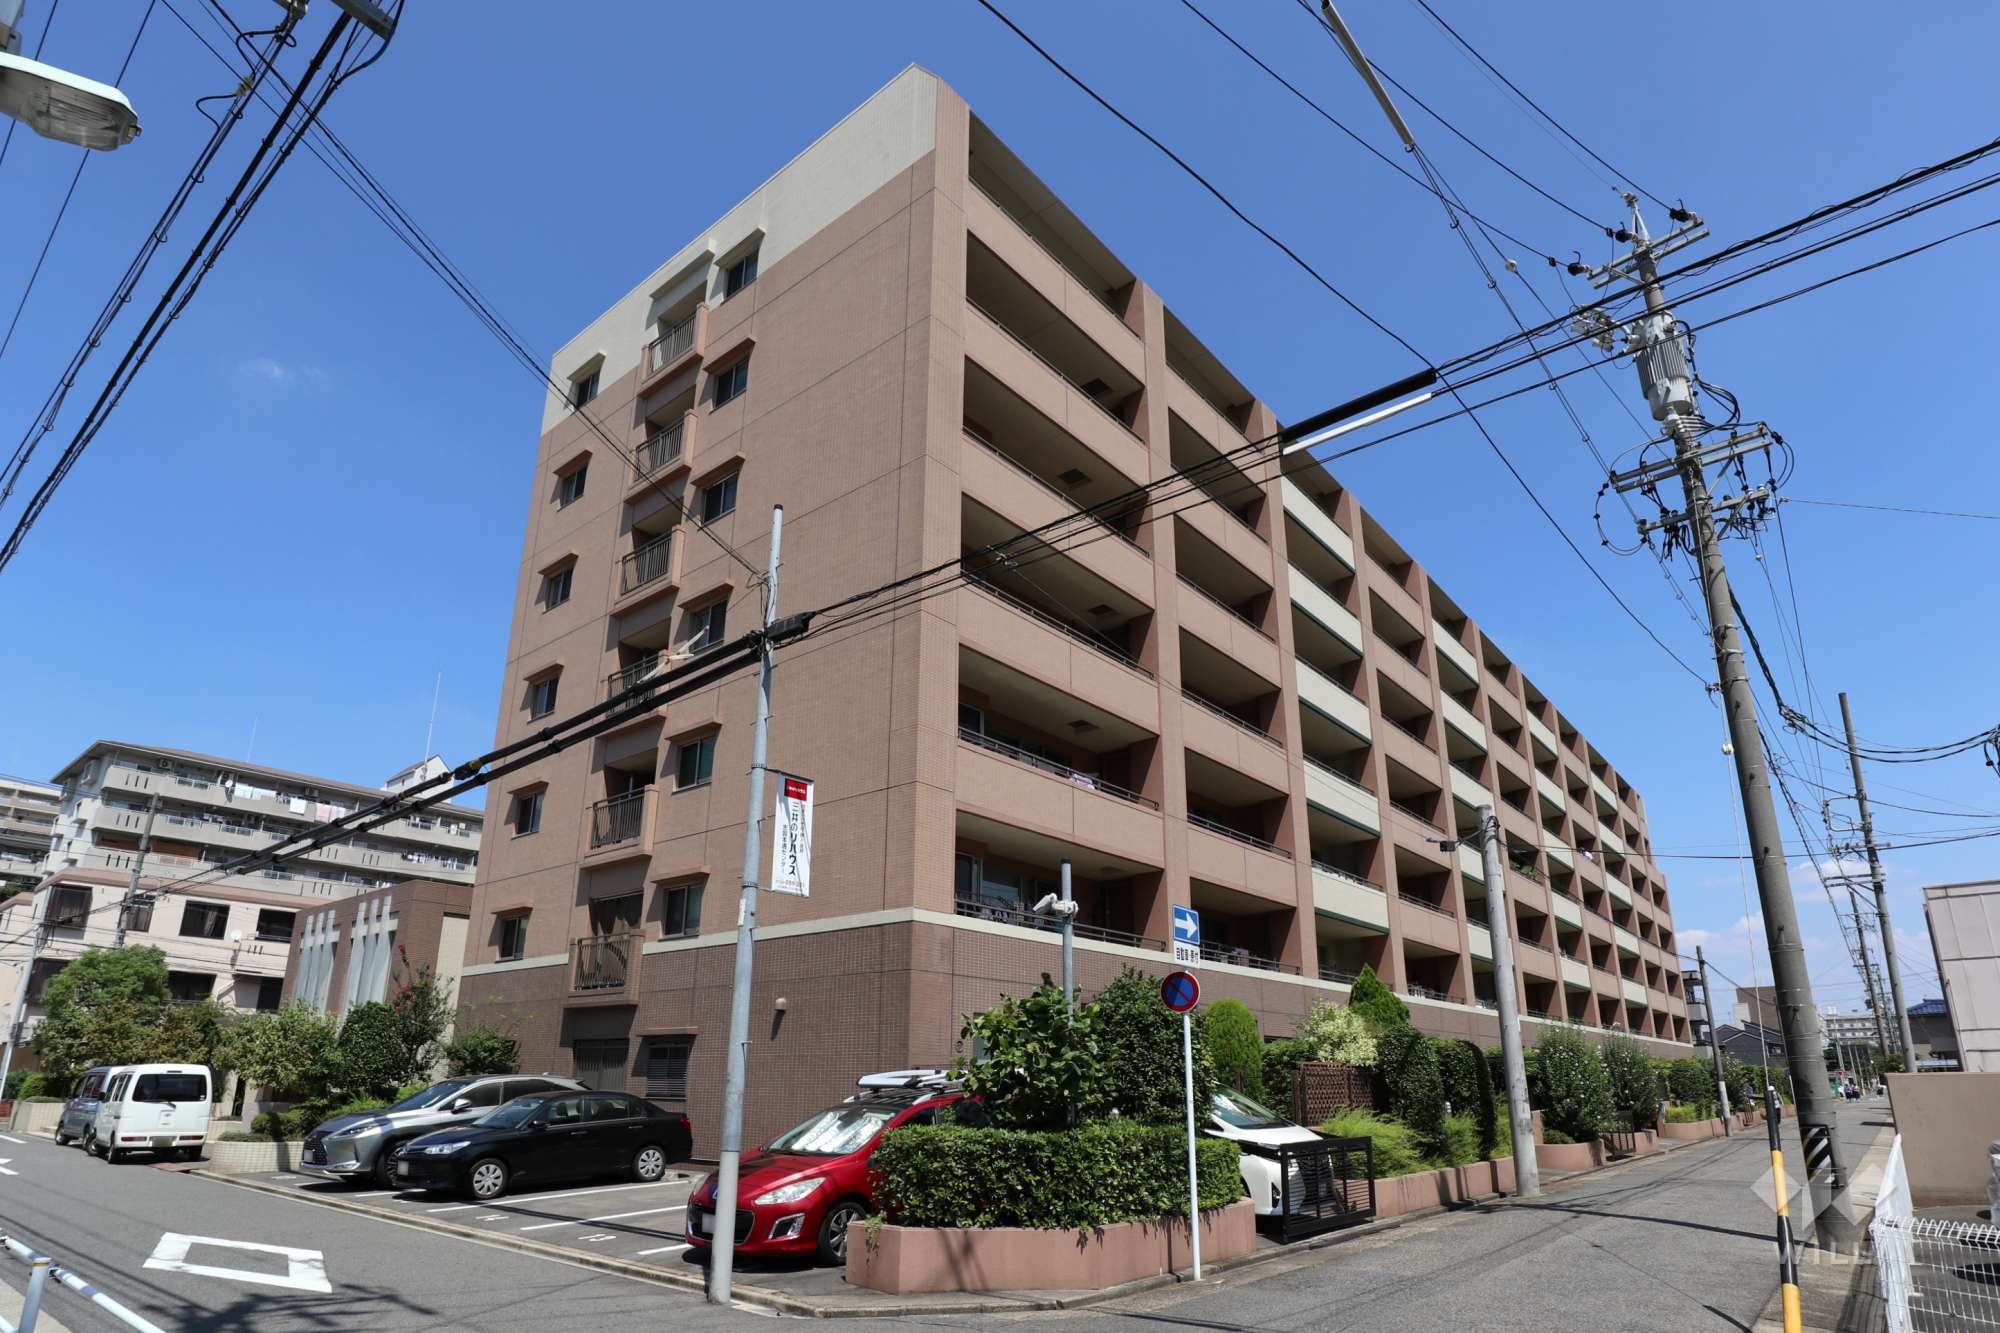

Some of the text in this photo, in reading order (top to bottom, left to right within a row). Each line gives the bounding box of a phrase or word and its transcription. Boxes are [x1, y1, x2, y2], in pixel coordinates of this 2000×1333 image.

[788, 801, 800, 876] 三井のリハウス
